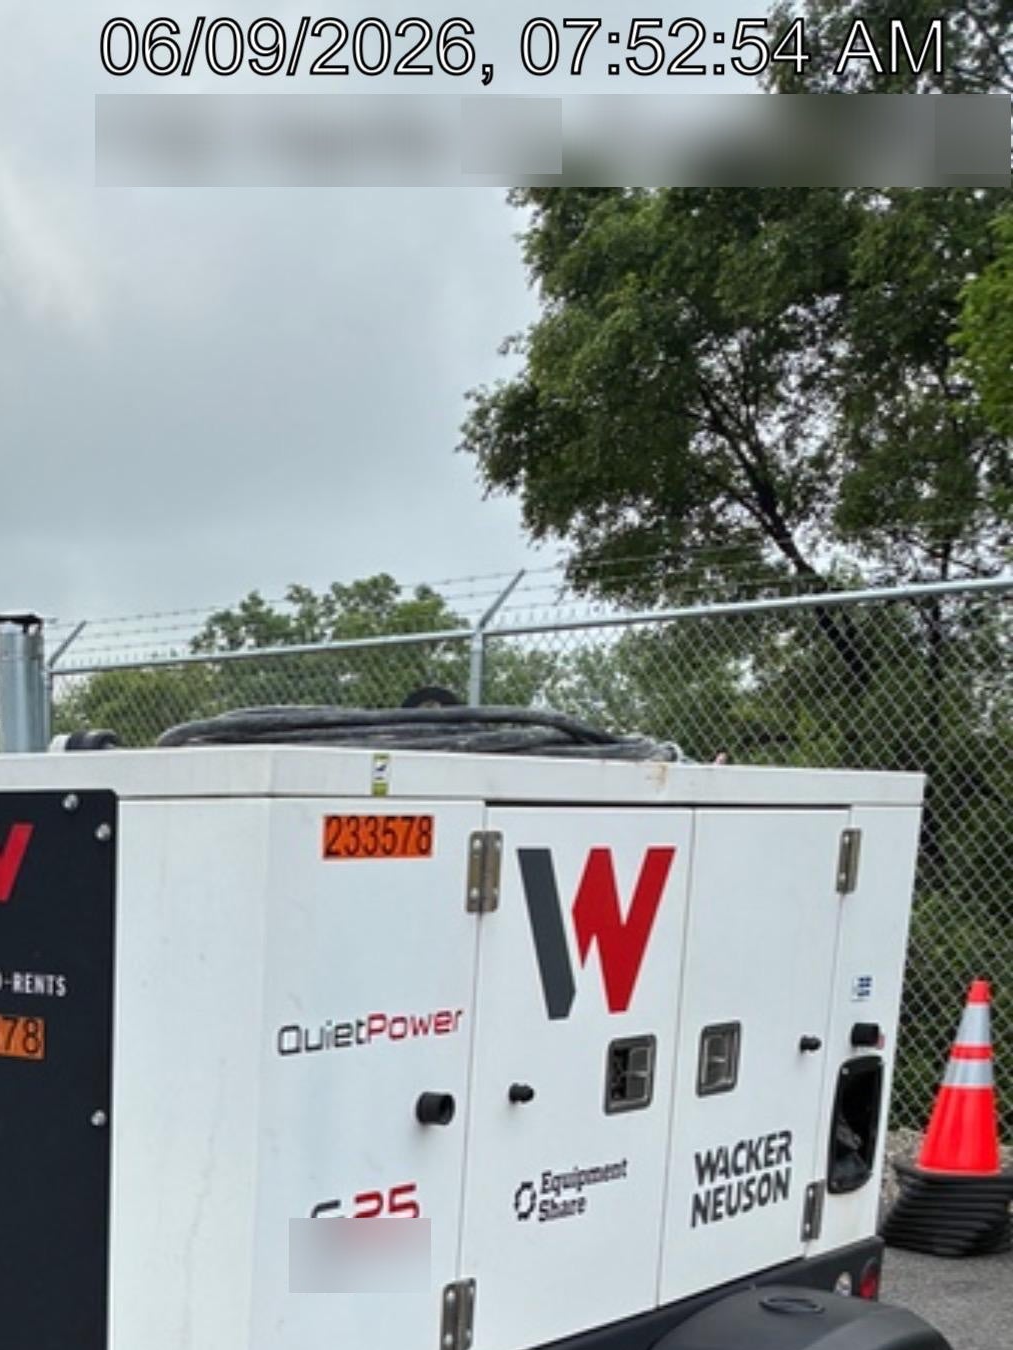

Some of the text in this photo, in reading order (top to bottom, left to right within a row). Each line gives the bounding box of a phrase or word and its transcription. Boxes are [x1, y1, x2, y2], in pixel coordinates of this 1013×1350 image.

[324, 815, 432, 857] 233578
[277, 1008, 464, 1056] QuietPower
[539, 1157, 628, 1197] Equipment
[694, 1130, 792, 1186] WACKER
[538, 1196, 586, 1222] Share
[690, 1167, 791, 1228] NEUSON
